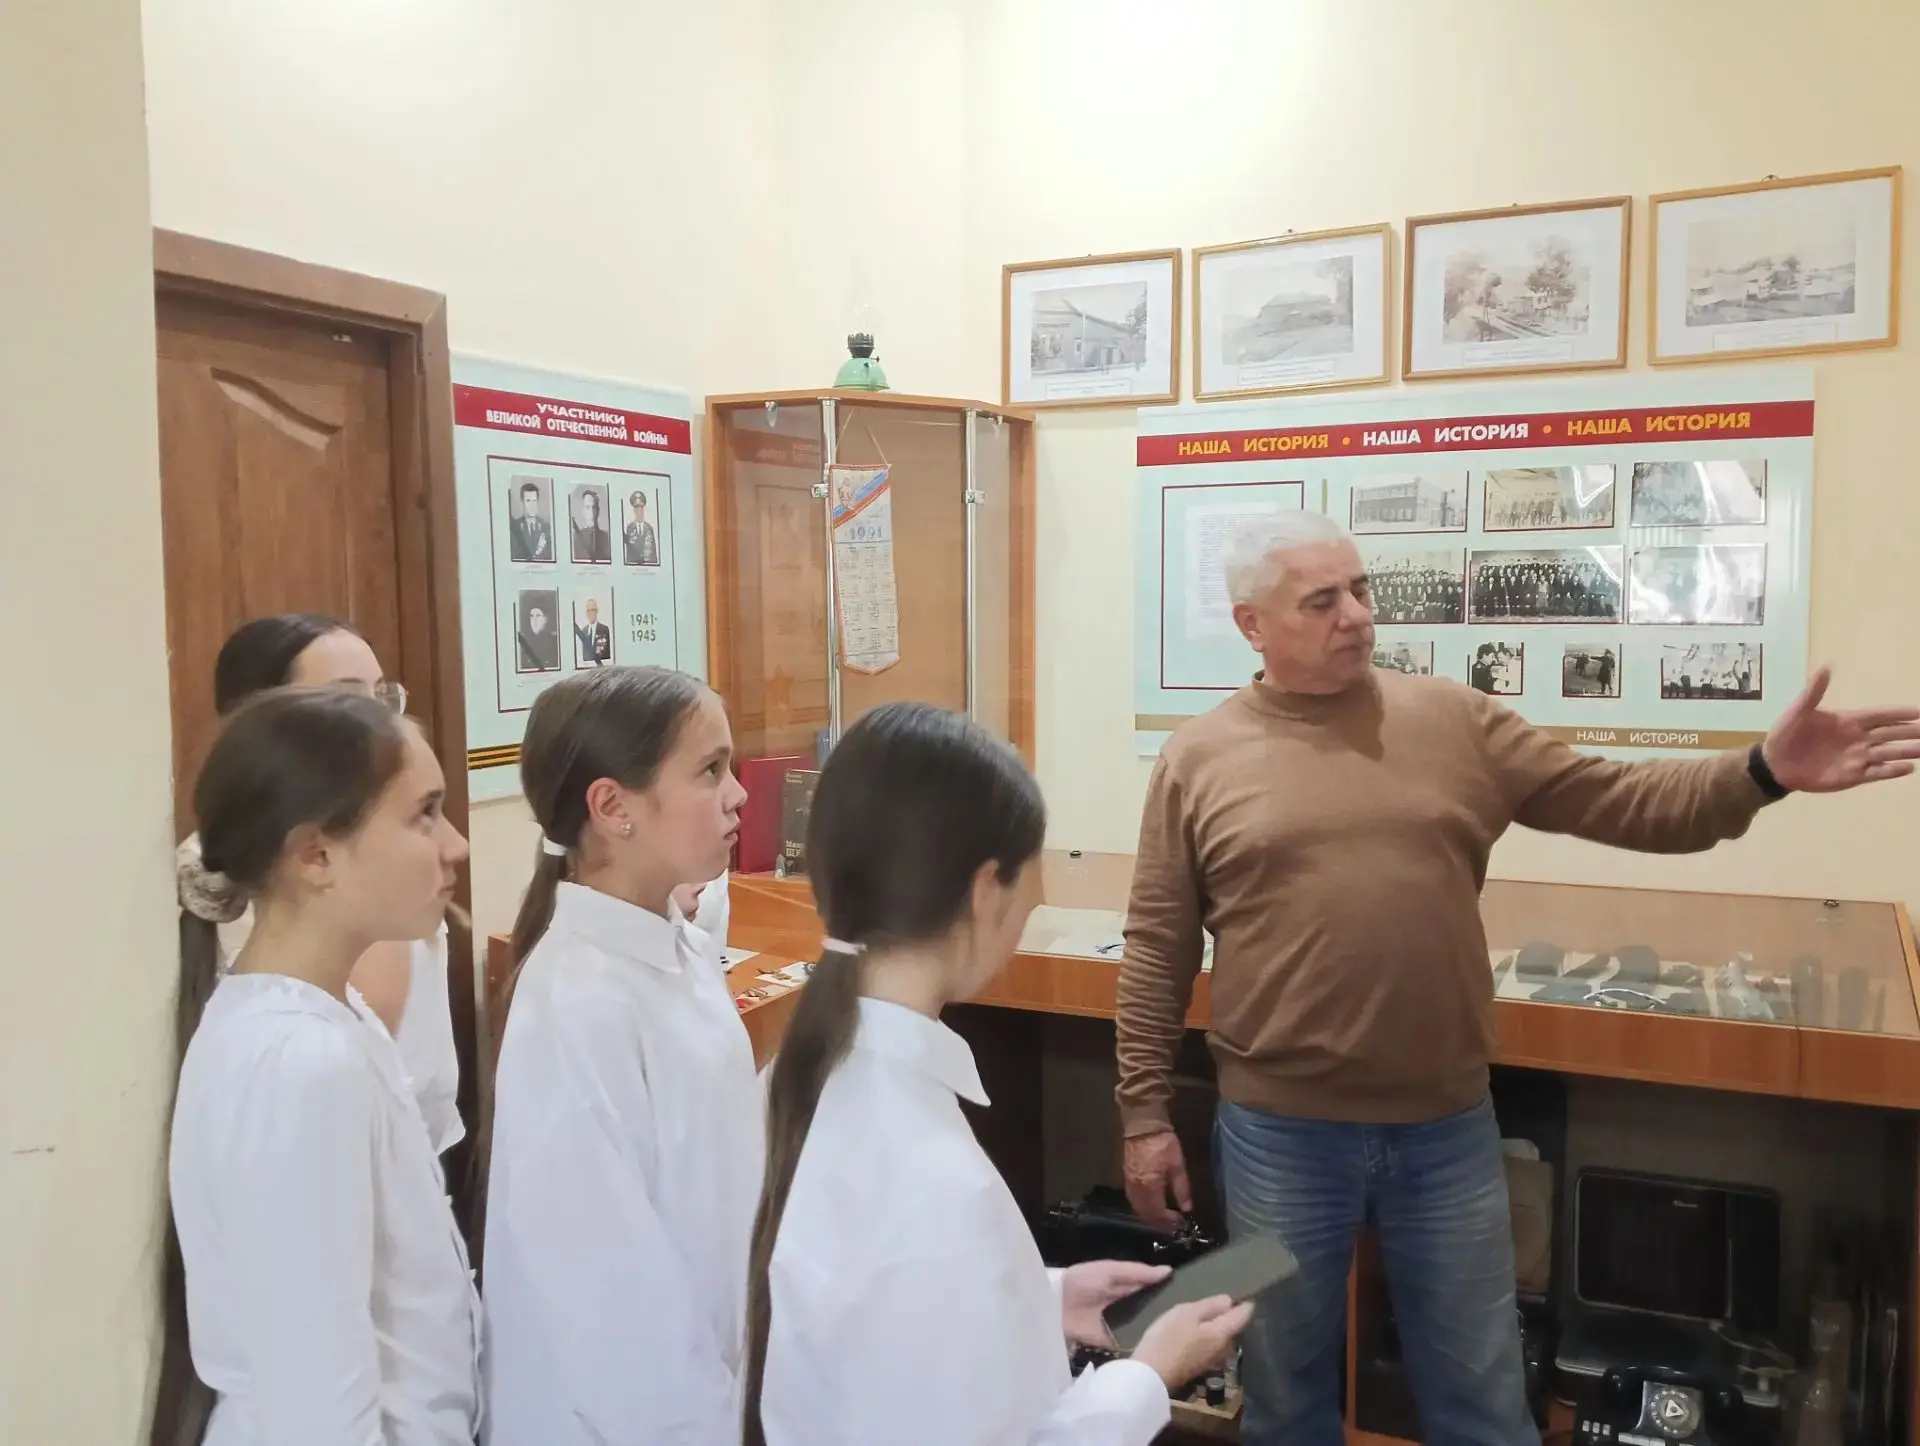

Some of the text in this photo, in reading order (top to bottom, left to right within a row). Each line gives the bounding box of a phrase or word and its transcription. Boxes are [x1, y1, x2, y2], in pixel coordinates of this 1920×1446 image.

[537, 403, 626, 425] УЧАСТНИКИ
[486, 410, 668, 445] ВЕЛИКОЙ ОТЕЧЕСТВЕННОЙ ВОЙНЫ
[1179, 412, 1751, 456] НАША ИСТОРИЯ НАША ИСТОРИЯ НАША ИСТОРИЯ
[631, 630, 656, 642] 1945
[1576, 730, 1699, 744] НАША ИСТОРИЯ
